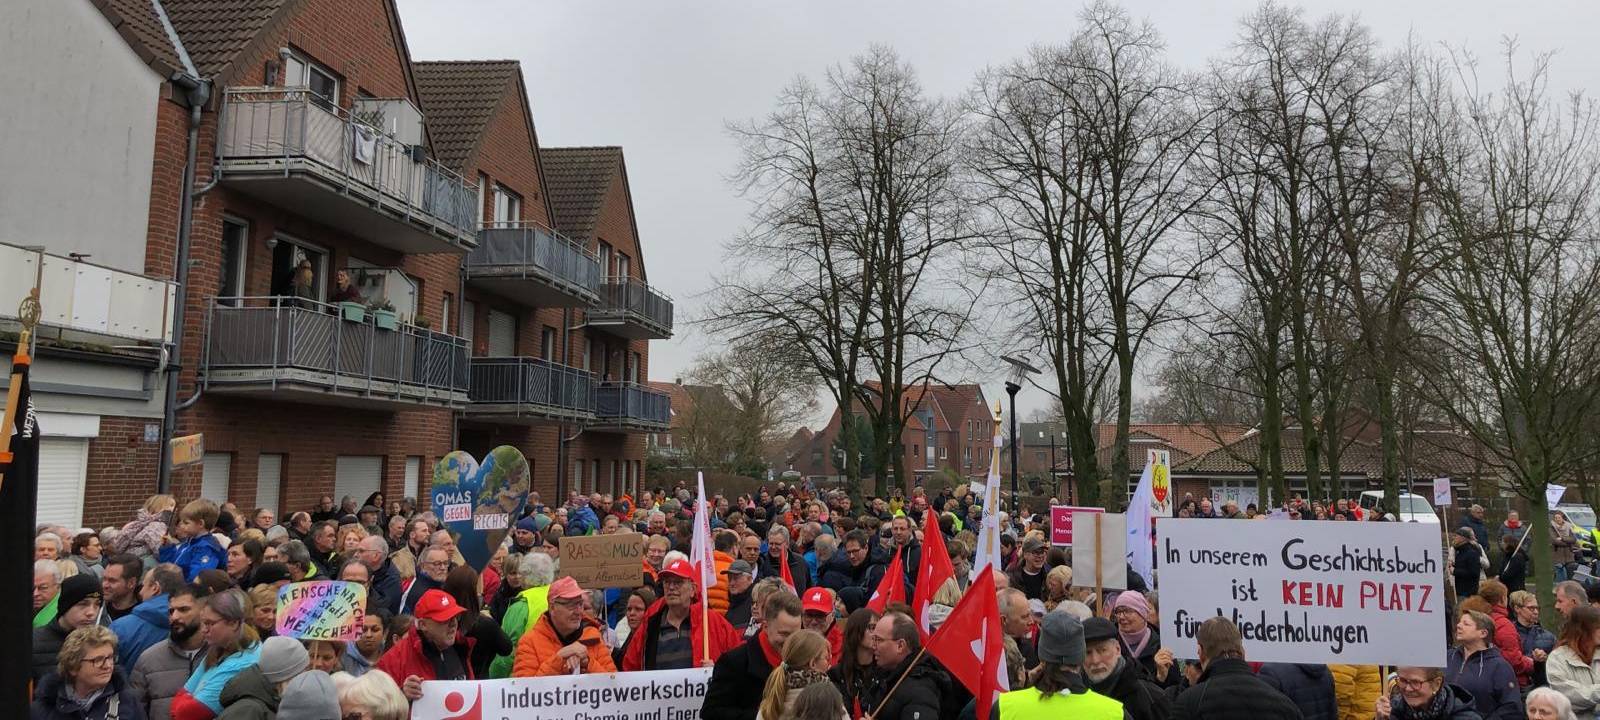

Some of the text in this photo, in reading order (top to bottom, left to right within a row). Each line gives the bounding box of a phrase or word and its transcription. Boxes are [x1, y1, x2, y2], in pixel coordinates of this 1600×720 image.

[436, 491, 471, 505] OMAS
[445, 505, 471, 520] GEGEN
[1166, 538, 1436, 574] In unserem Geschichtsbuch
[1232, 578, 1433, 613] ist KEIN PLATZ
[284, 615, 353, 638] MENSCHEN
[667, 706, 704, 720] Ener
